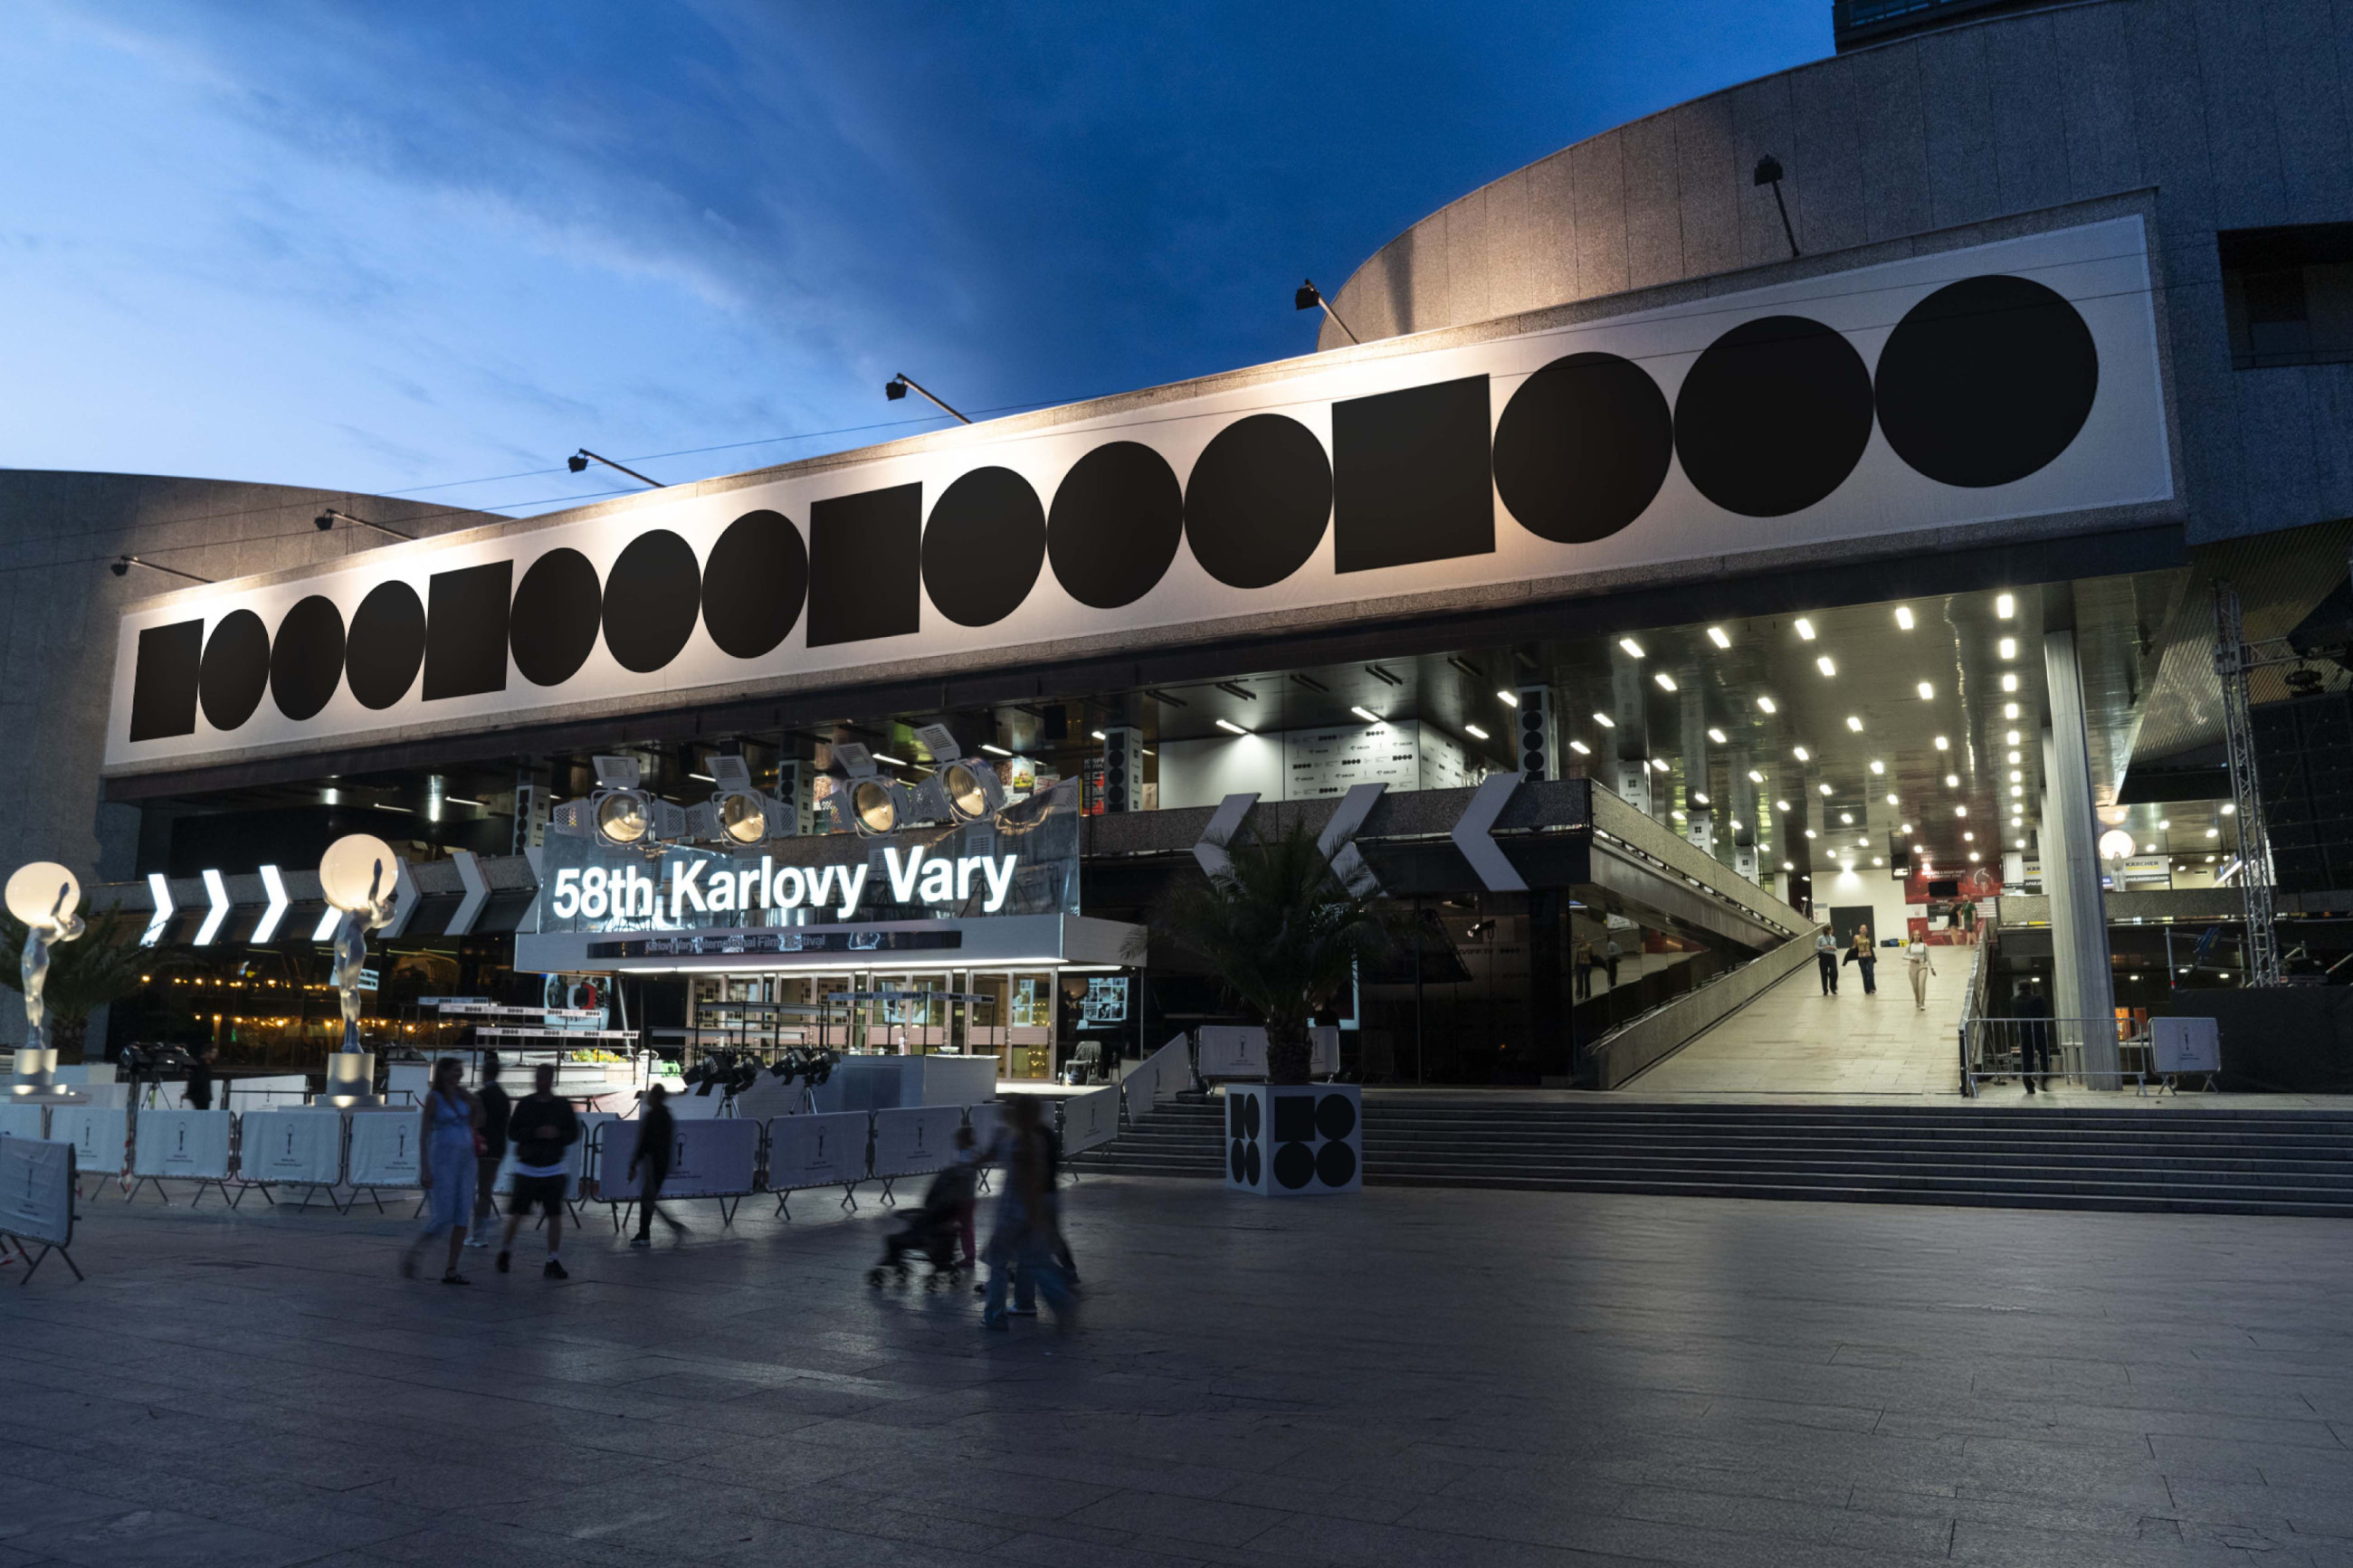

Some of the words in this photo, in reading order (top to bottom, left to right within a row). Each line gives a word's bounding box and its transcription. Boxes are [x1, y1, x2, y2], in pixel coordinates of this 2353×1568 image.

[553, 865, 653, 918] 58th
[671, 856, 869, 919] Karlovy
[883, 845, 1018, 913] Vary
[645, 940, 673, 952] Karlovy
[675, 939, 694, 952] Vary
[696, 936, 756, 949] International
[757, 935, 780, 947] Film
